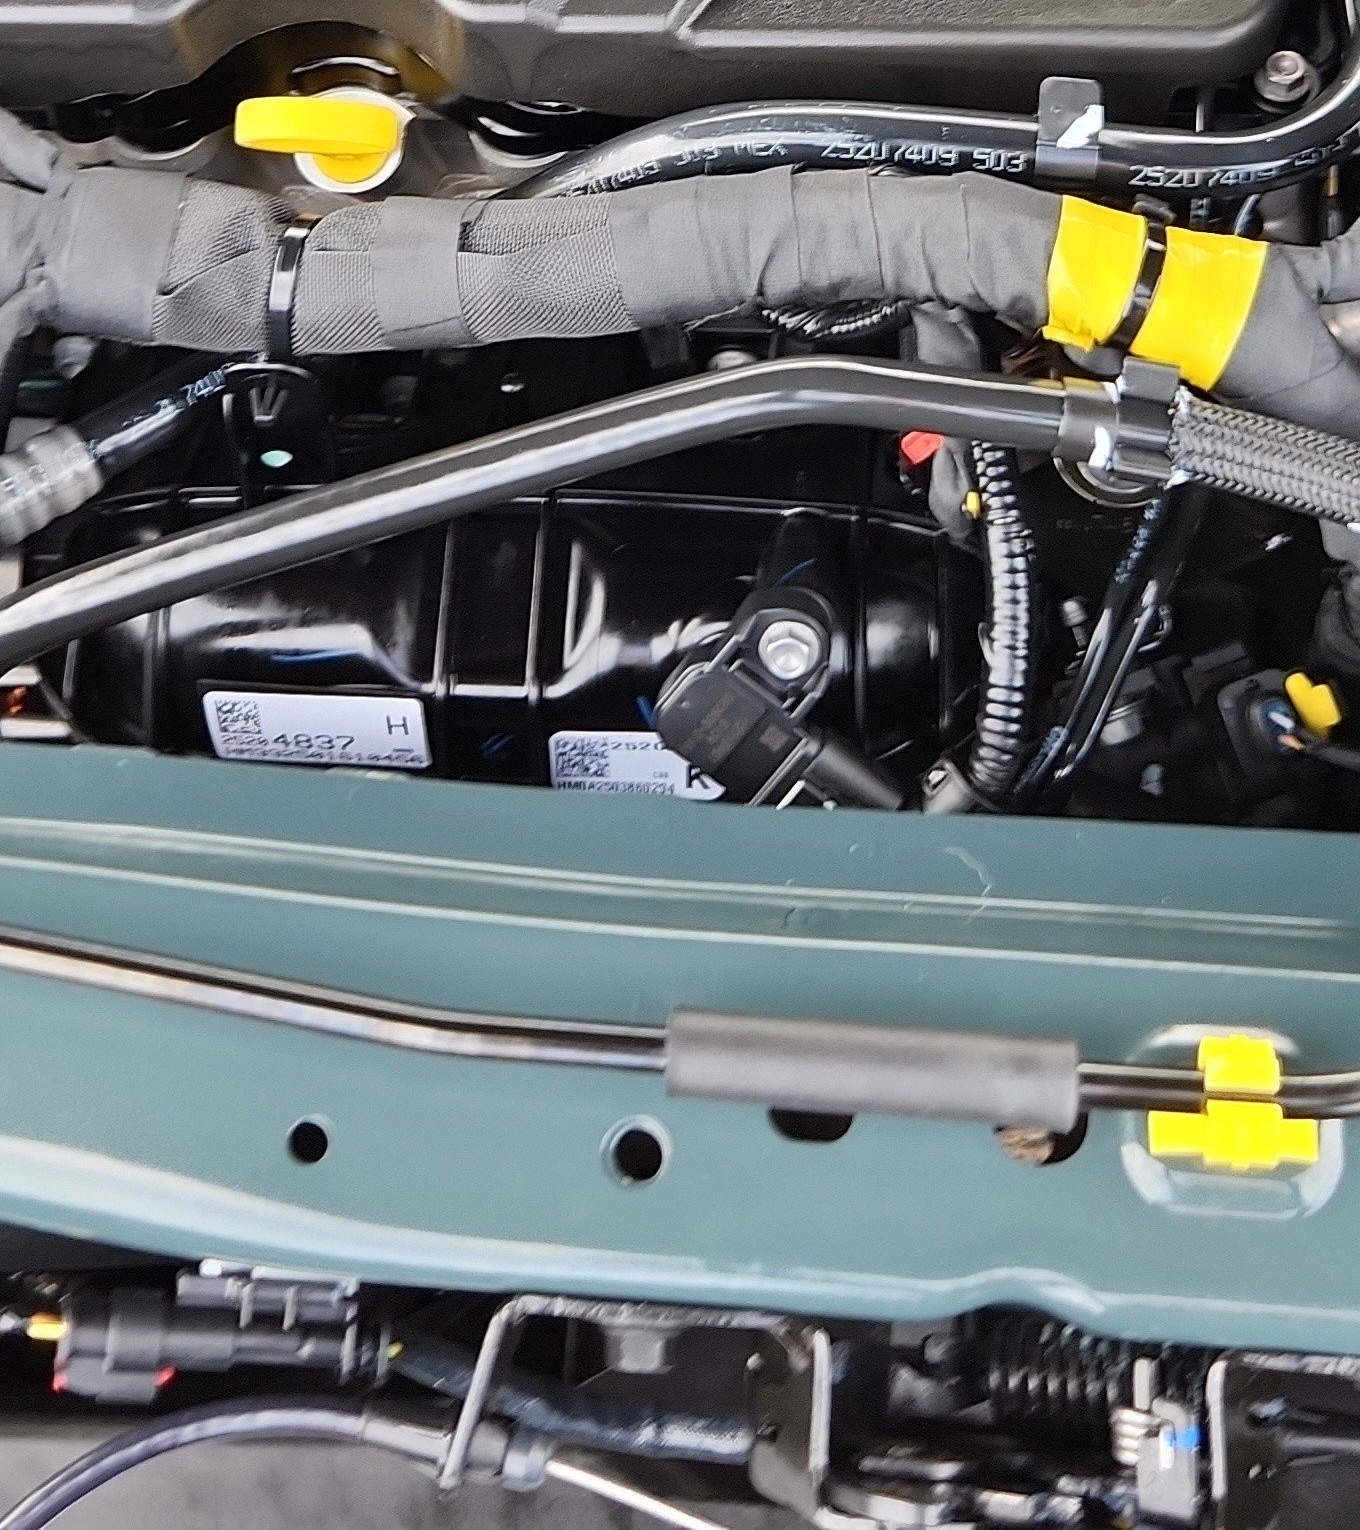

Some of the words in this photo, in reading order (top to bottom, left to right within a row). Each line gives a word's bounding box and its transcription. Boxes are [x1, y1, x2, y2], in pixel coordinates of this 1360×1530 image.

[972, 149, 1029, 173] 503
[386, 715, 410, 735] H
[273, 733, 356, 751] 4837
